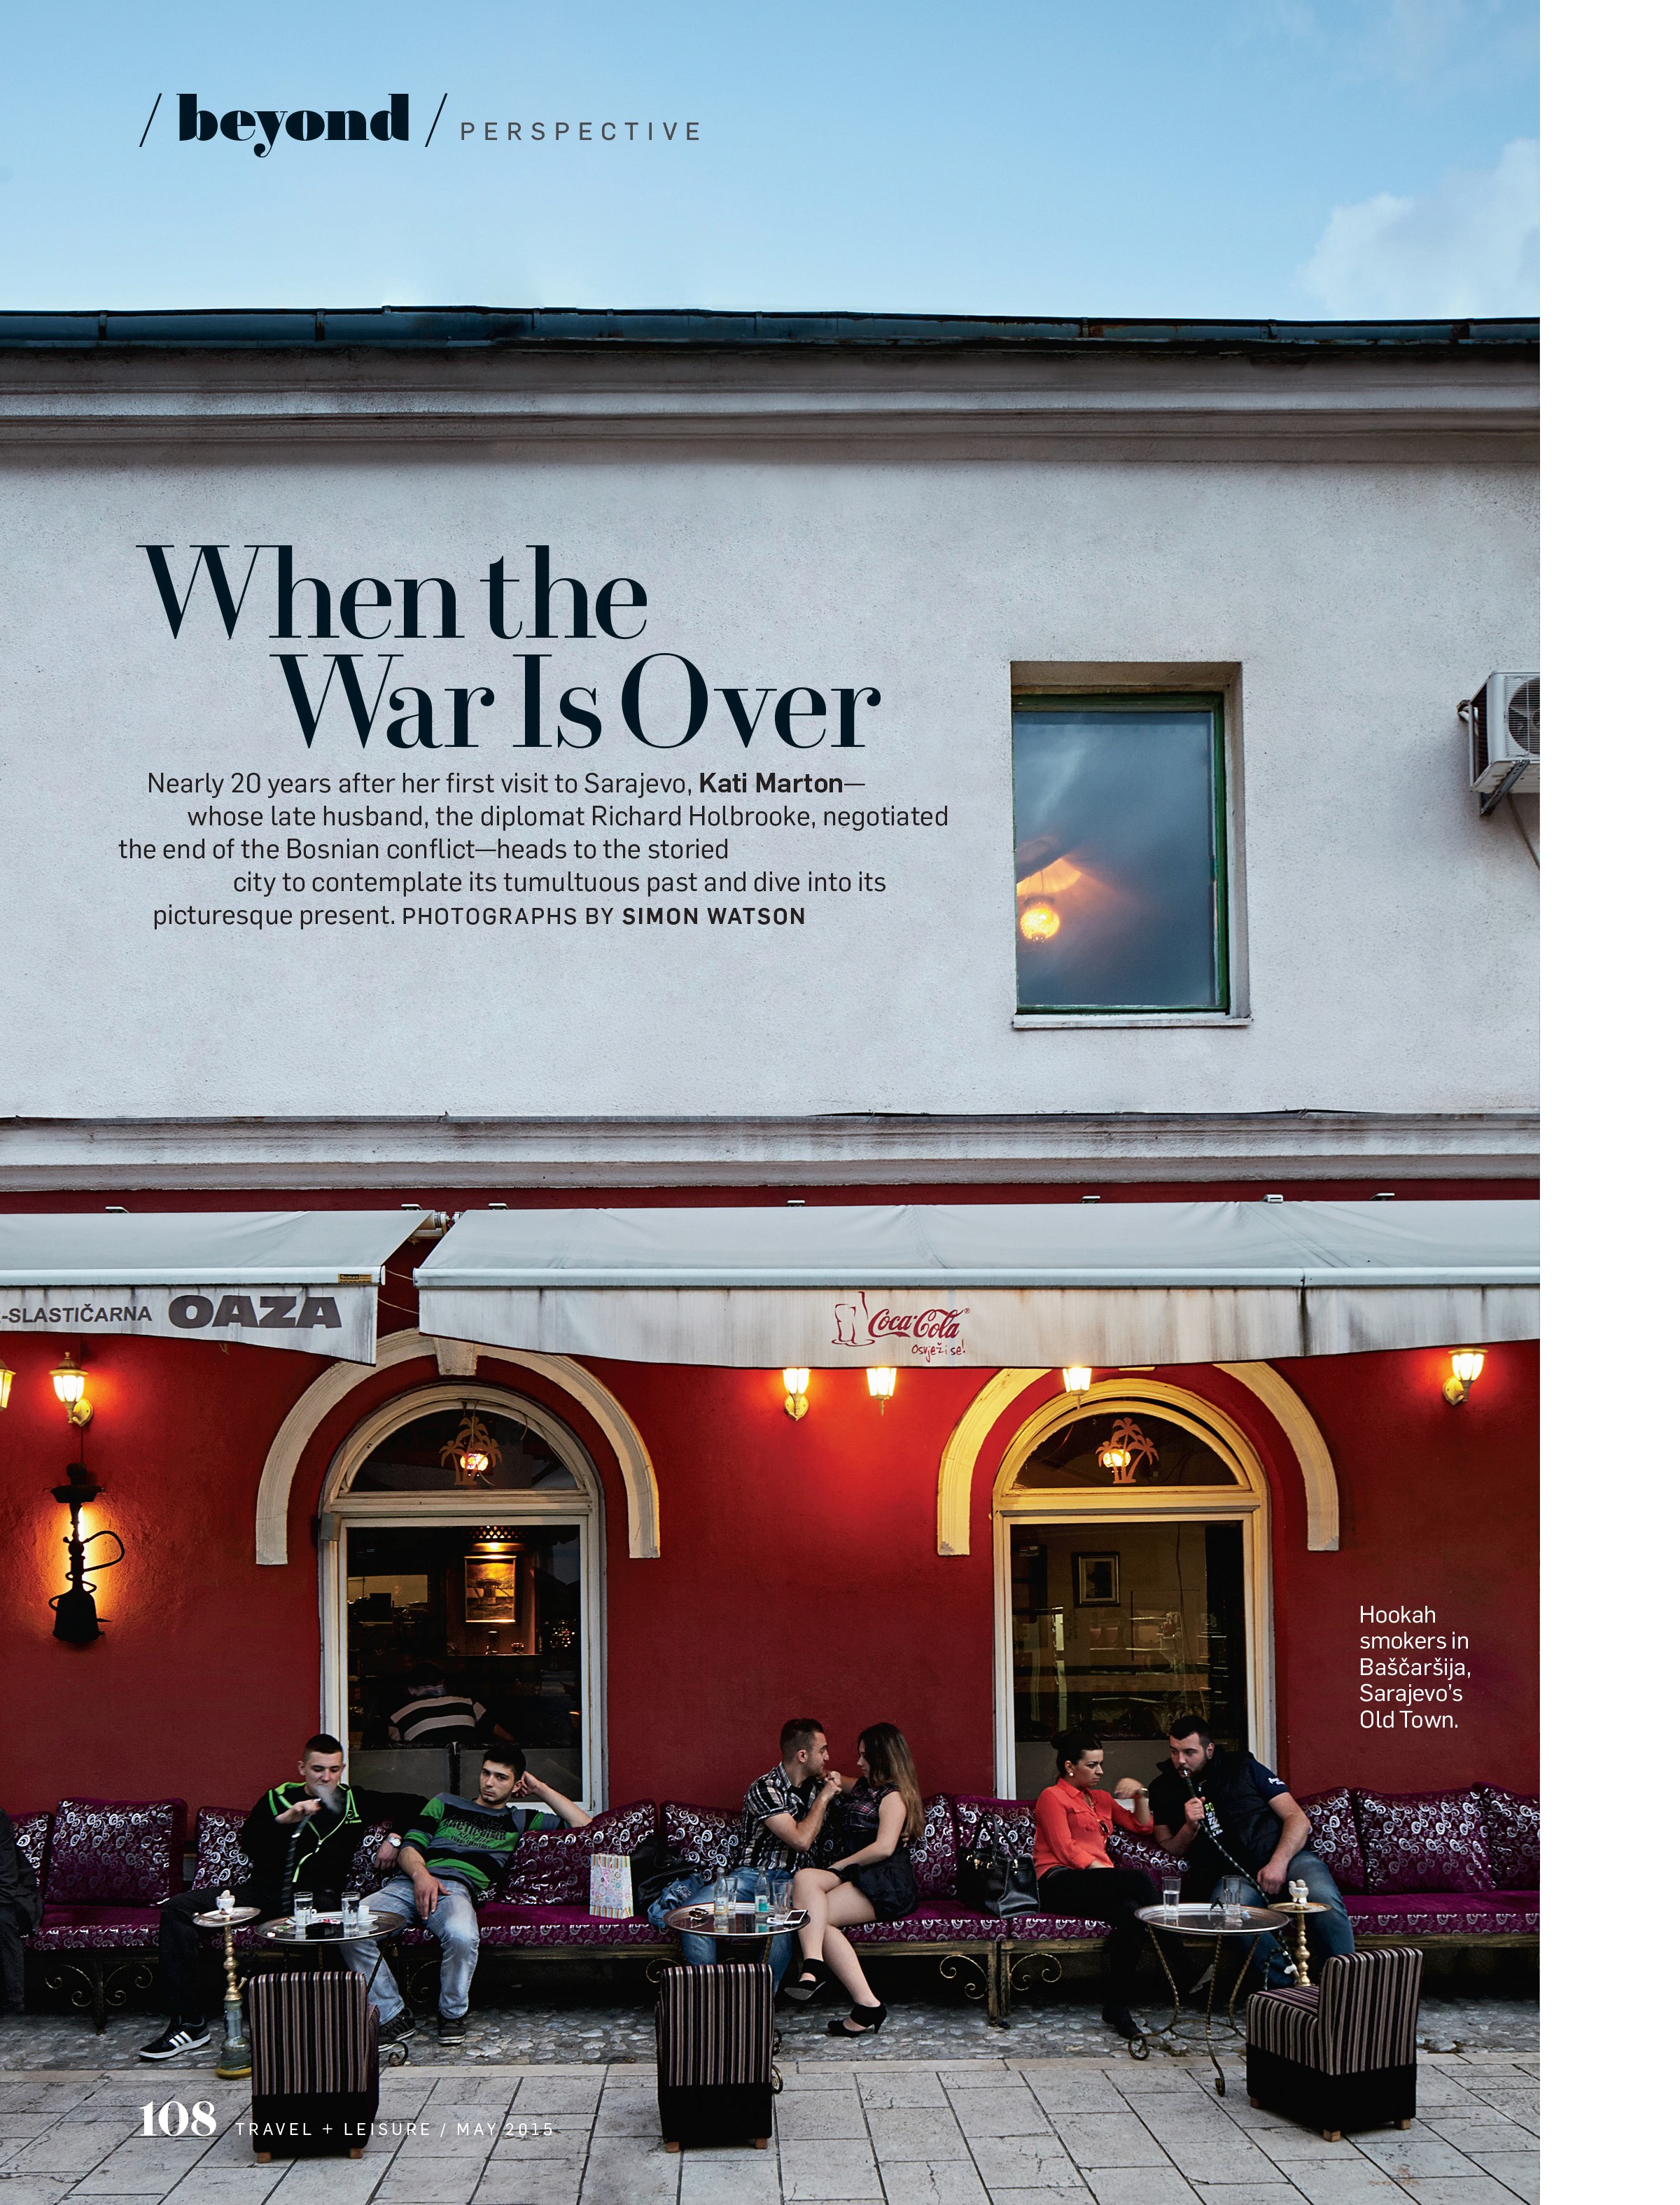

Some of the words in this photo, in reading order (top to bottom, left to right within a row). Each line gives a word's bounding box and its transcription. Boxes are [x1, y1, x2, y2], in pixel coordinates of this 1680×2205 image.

[0, 1304, 152, 1323] -SLASTIČARNA
[169, 1295, 342, 1329] OAZA
[868, 1308, 963, 1338] Coca-Cola
[951, 1339, 966, 1355] se!
